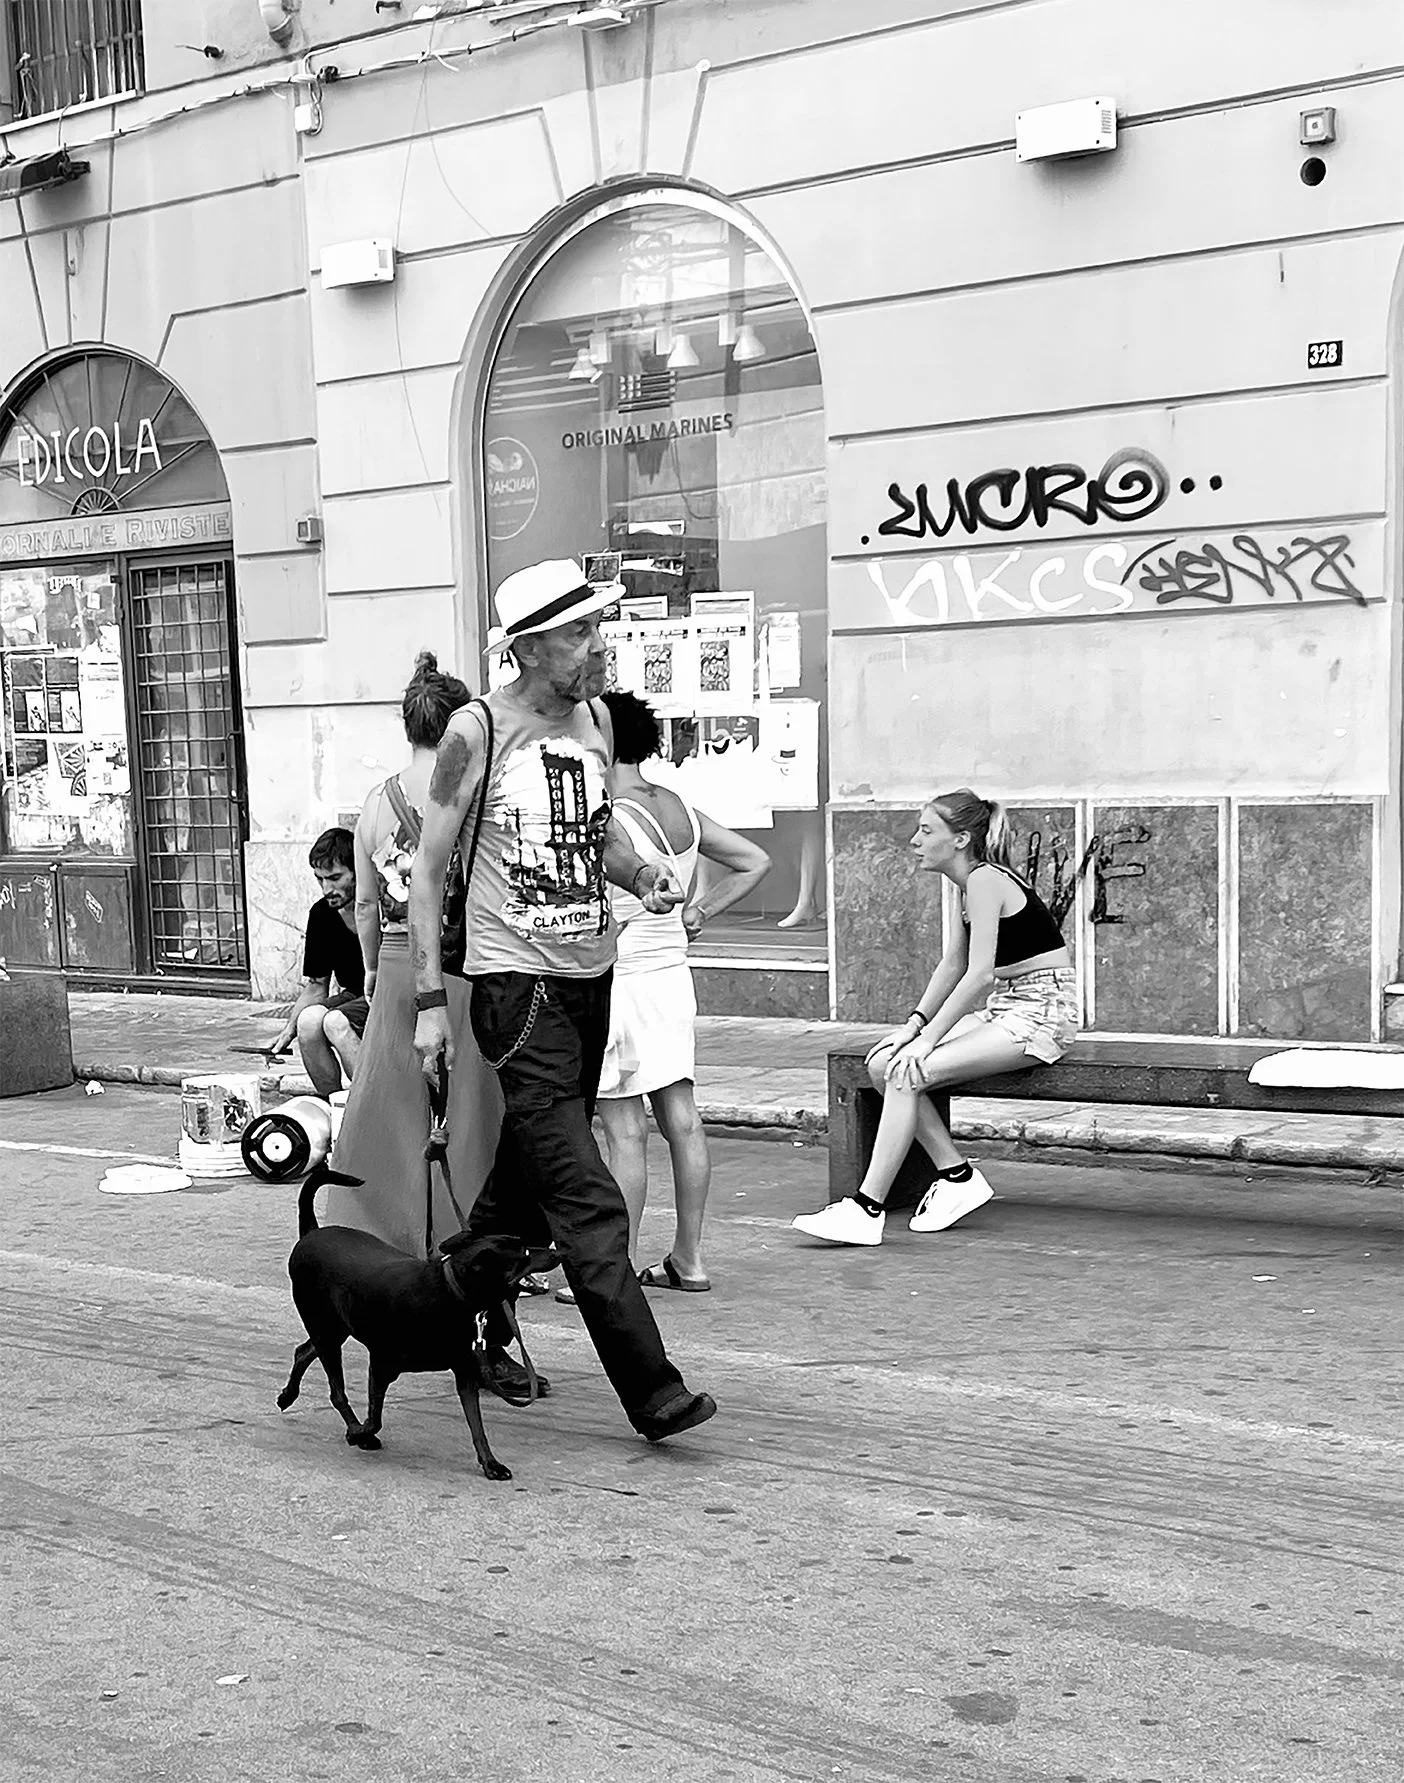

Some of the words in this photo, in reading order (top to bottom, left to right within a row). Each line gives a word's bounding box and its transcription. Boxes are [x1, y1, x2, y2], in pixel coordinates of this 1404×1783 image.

[1309, 342, 1338, 366] 328
[561, 424, 646, 449] ORIGINAL
[649, 412, 733, 441] MARINES
[17, 418, 163, 487] EDICOLA
[100, 523, 118, 547] E
[125, 511, 230, 544] RIVISTE
[533, 909, 591, 928] CLAYTON
